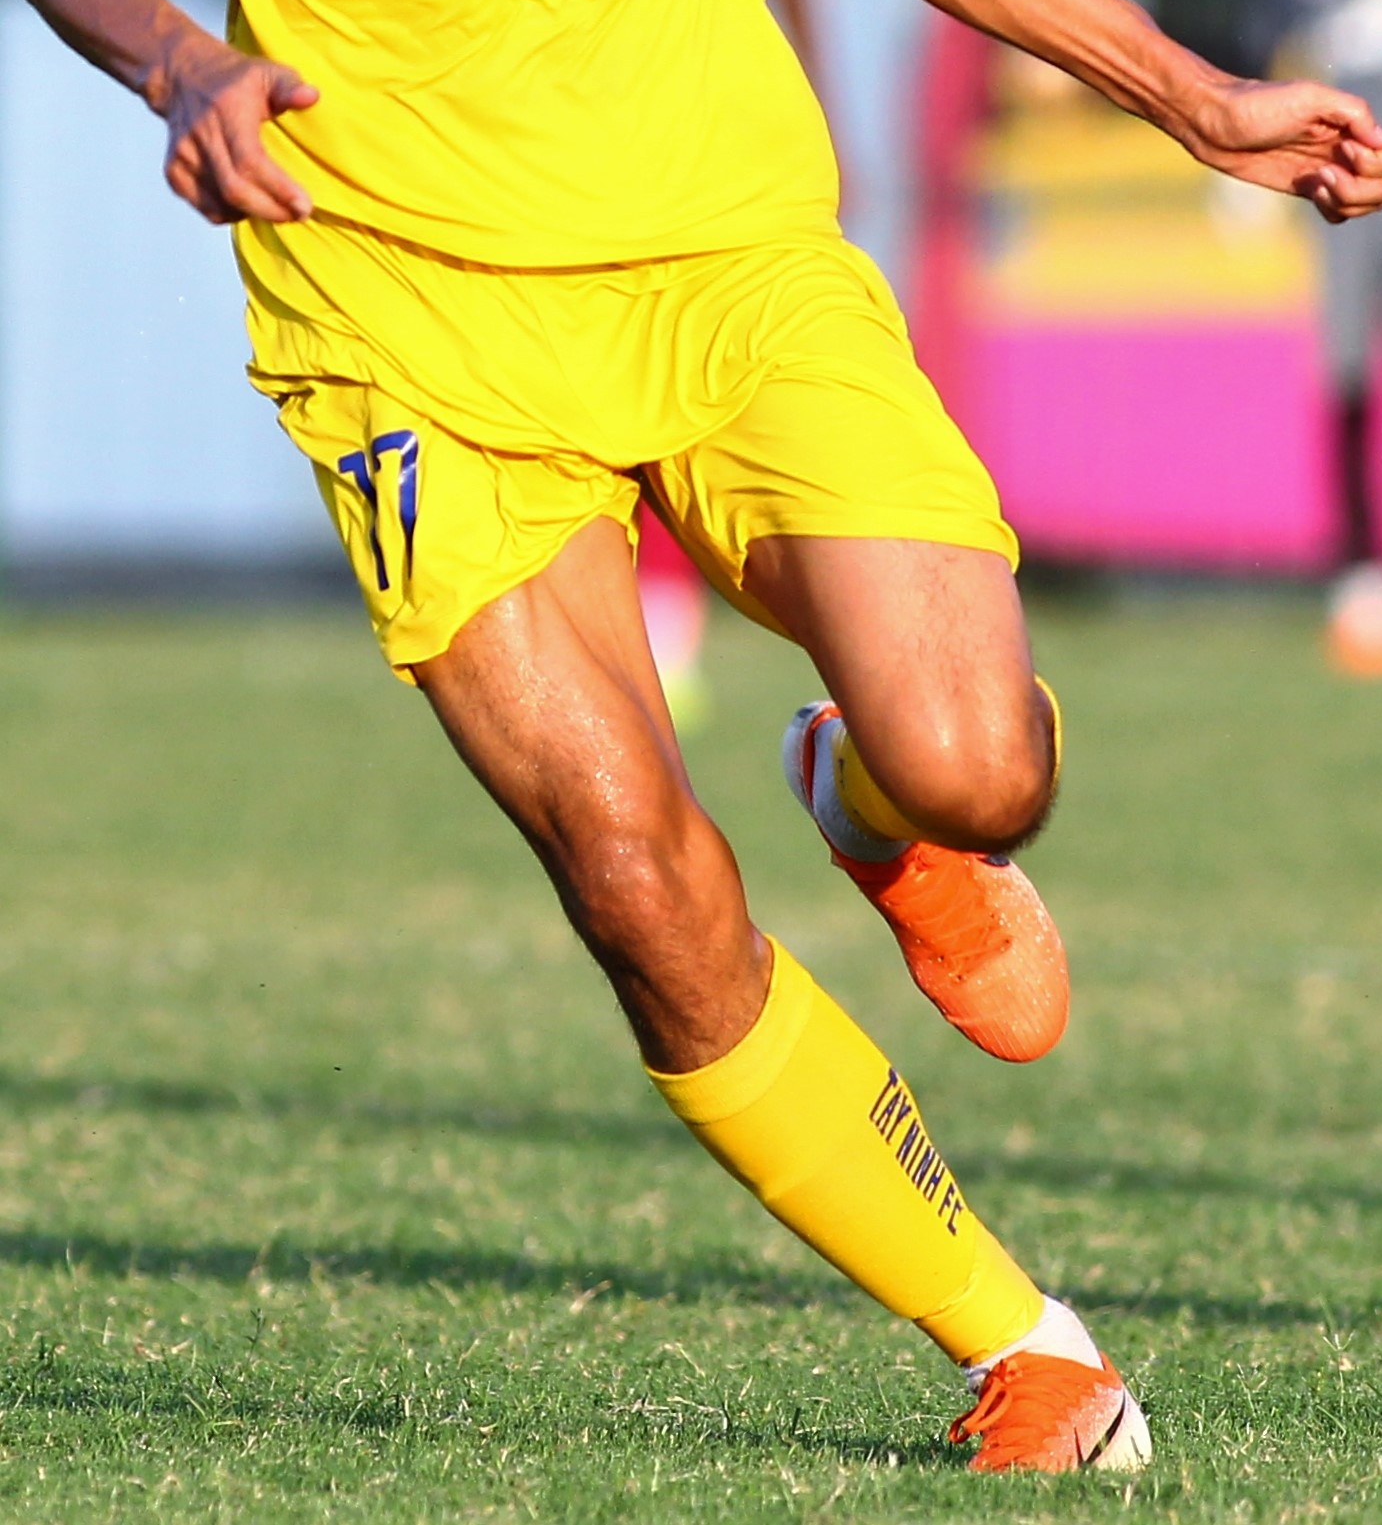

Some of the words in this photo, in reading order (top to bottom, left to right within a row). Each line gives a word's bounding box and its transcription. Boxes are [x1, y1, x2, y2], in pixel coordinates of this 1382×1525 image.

[338, 429, 419, 591] 17
[868, 1066, 913, 1145] TAY
[895, 1117, 946, 1203] NINH
[937, 1181, 964, 1236] FC
